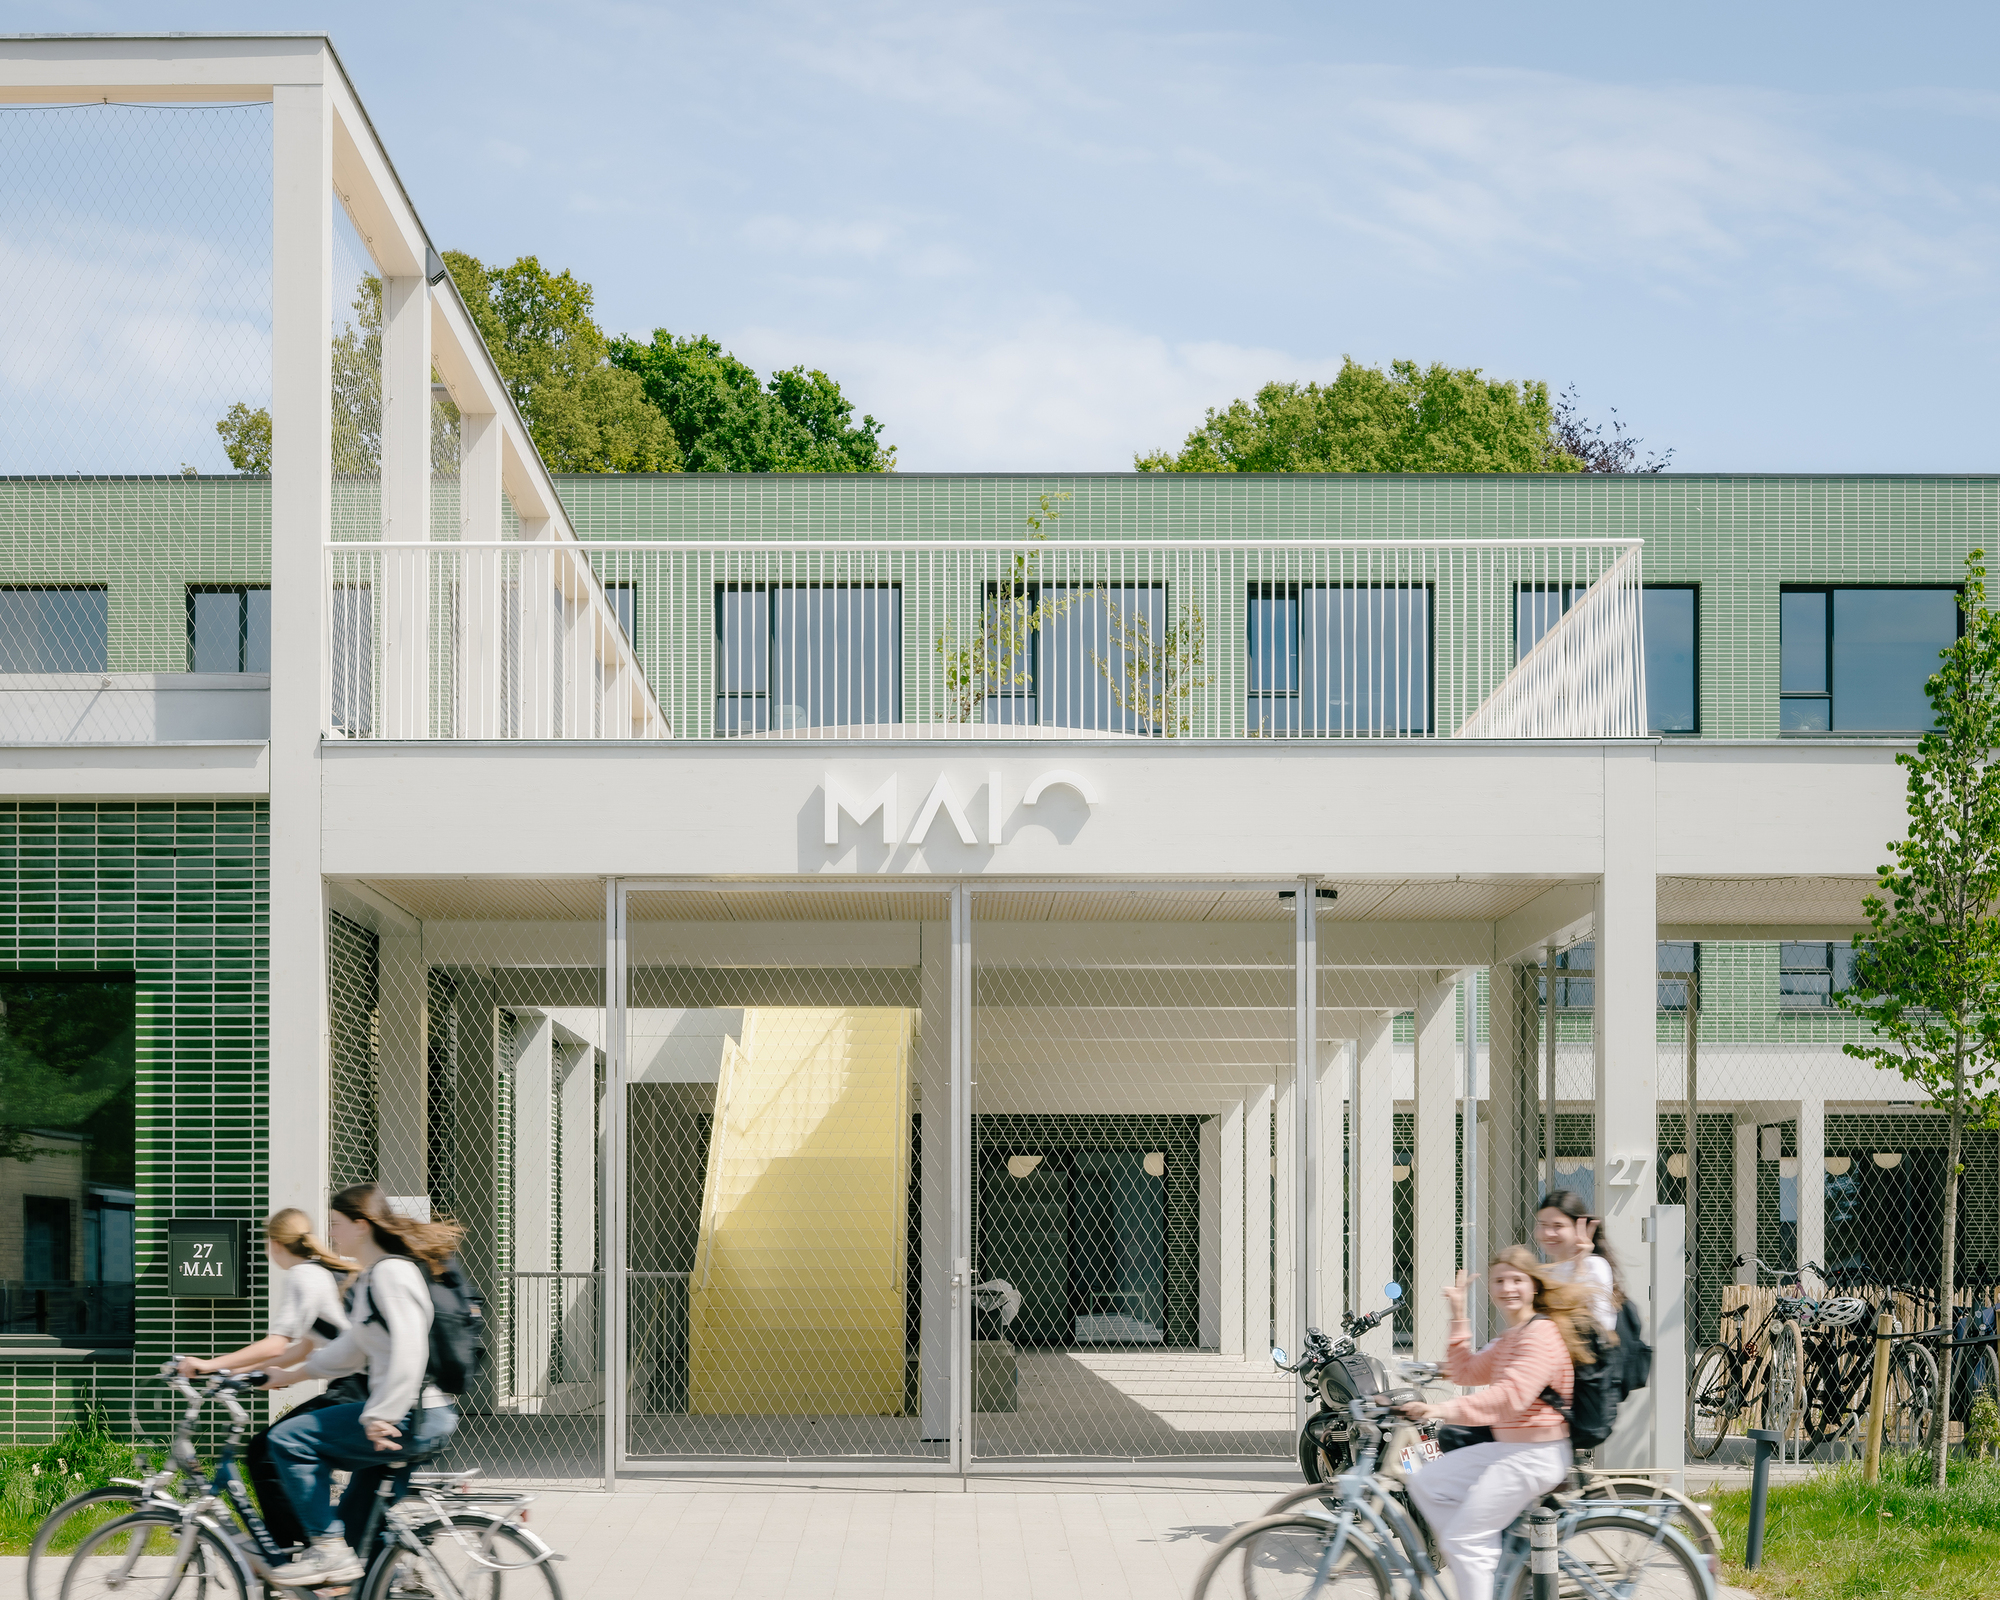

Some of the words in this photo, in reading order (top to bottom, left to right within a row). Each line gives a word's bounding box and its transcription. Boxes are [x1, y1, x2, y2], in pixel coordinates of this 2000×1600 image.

[1609, 1153, 1655, 1186] 27
[193, 1243, 214, 1259] 27
[182, 1261, 224, 1277] MAI
